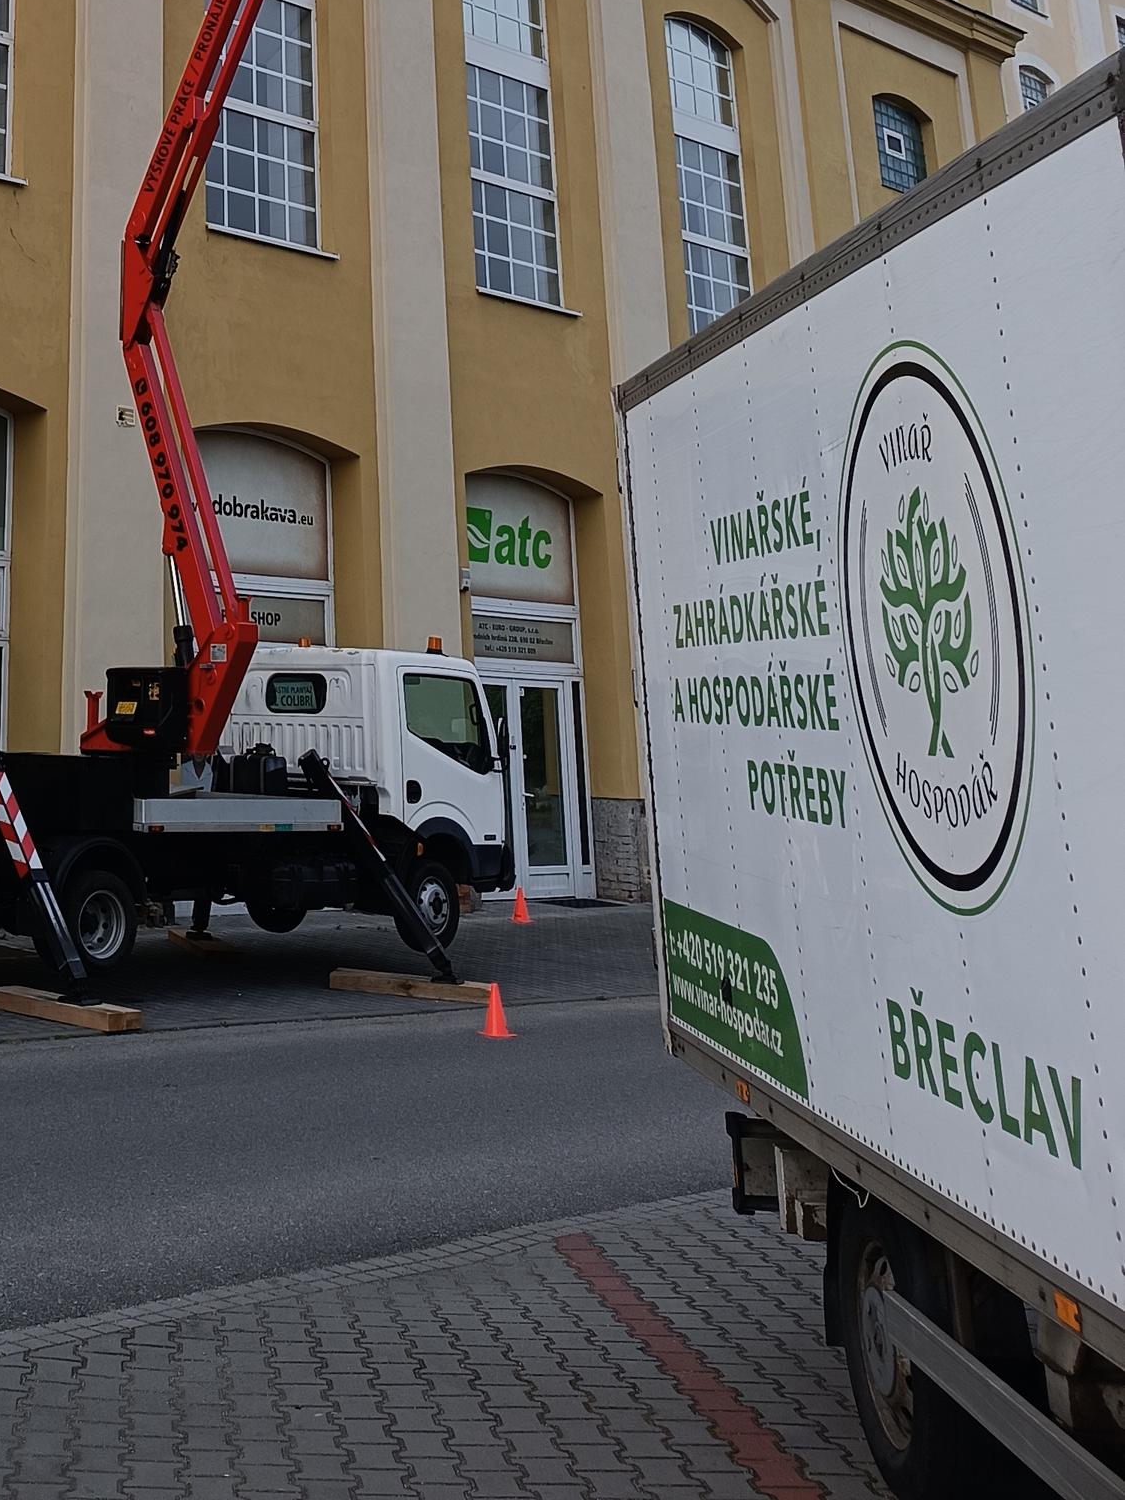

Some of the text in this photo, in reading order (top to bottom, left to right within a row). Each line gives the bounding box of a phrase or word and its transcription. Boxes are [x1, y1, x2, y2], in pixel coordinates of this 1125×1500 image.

[141, 401, 188, 552] 608 970 974
[494, 515, 552, 569] atc
[710, 475, 821, 566] VINAŘSKÉ,
[250, 611, 281, 626] SHOP
[673, 564, 831, 649] ZAHRÁDKÁŘSKÉ
[674, 658, 840, 731] A HOSPODÁŘSKÉ
[747, 750, 847, 829] POTŘEBY
[676, 929, 702, 971] +420
[703, 938, 725, 981] 519
[727, 948, 752, 995] 321
[753, 961, 779, 1010] 235
[672, 972, 784, 1058] www.vinar-hospodar.cz
[886, 987, 1082, 1171] BŘECLAV
